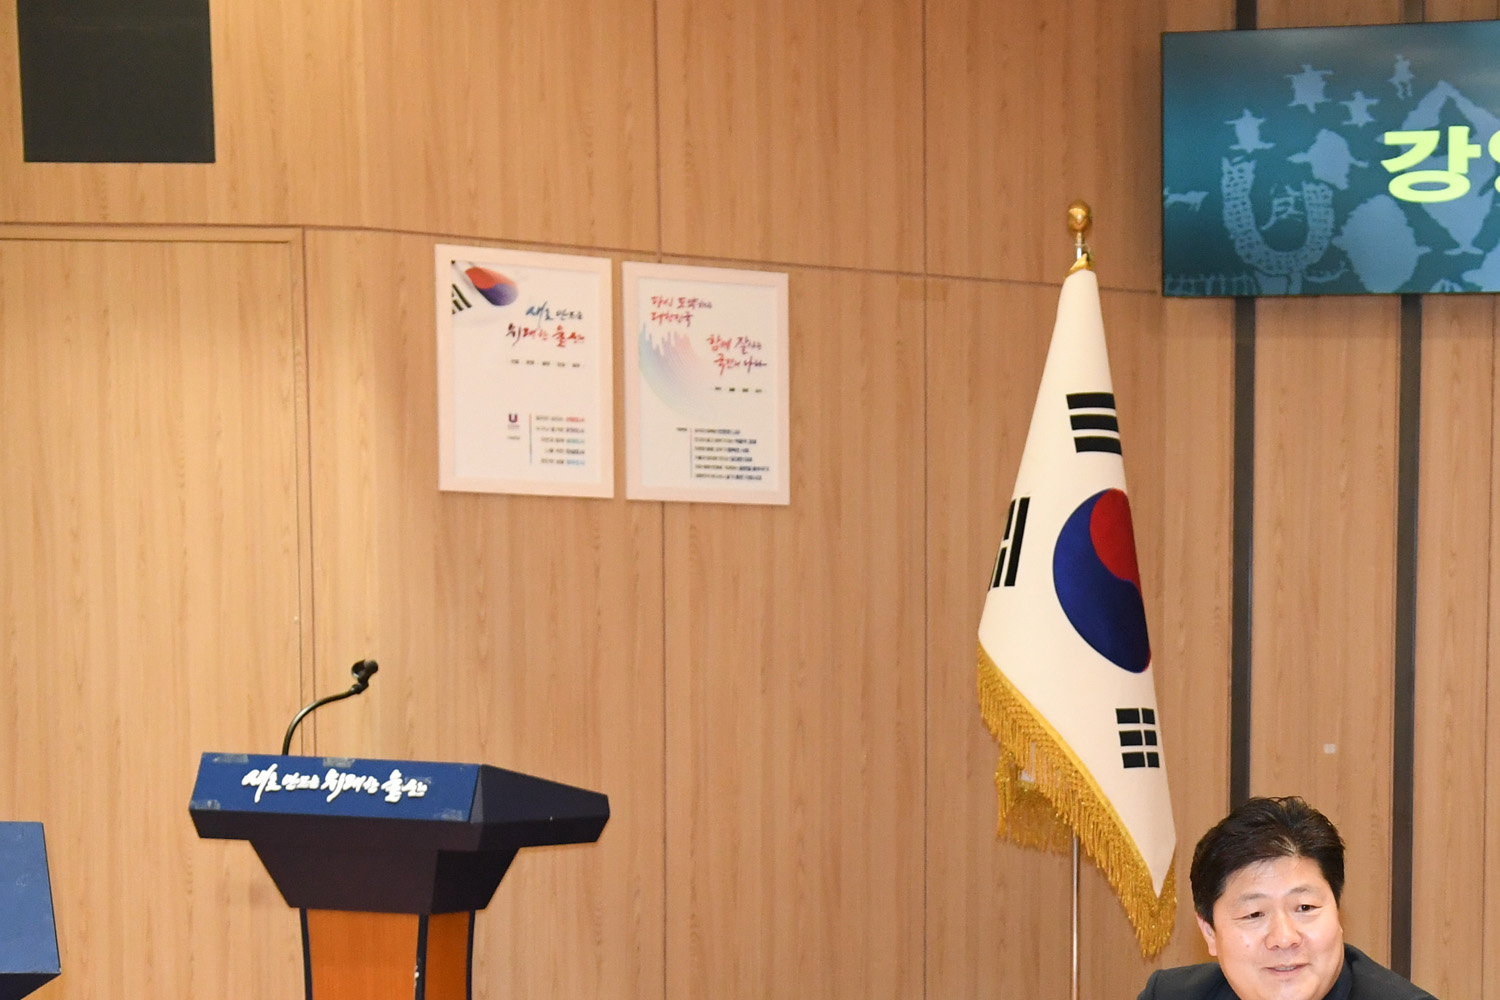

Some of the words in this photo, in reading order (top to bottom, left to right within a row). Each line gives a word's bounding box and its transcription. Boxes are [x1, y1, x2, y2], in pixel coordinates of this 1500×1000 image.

[241, 763, 281, 803] 새로
[320, 768, 380, 803] 위대한
[380, 768, 428, 803] 울산
